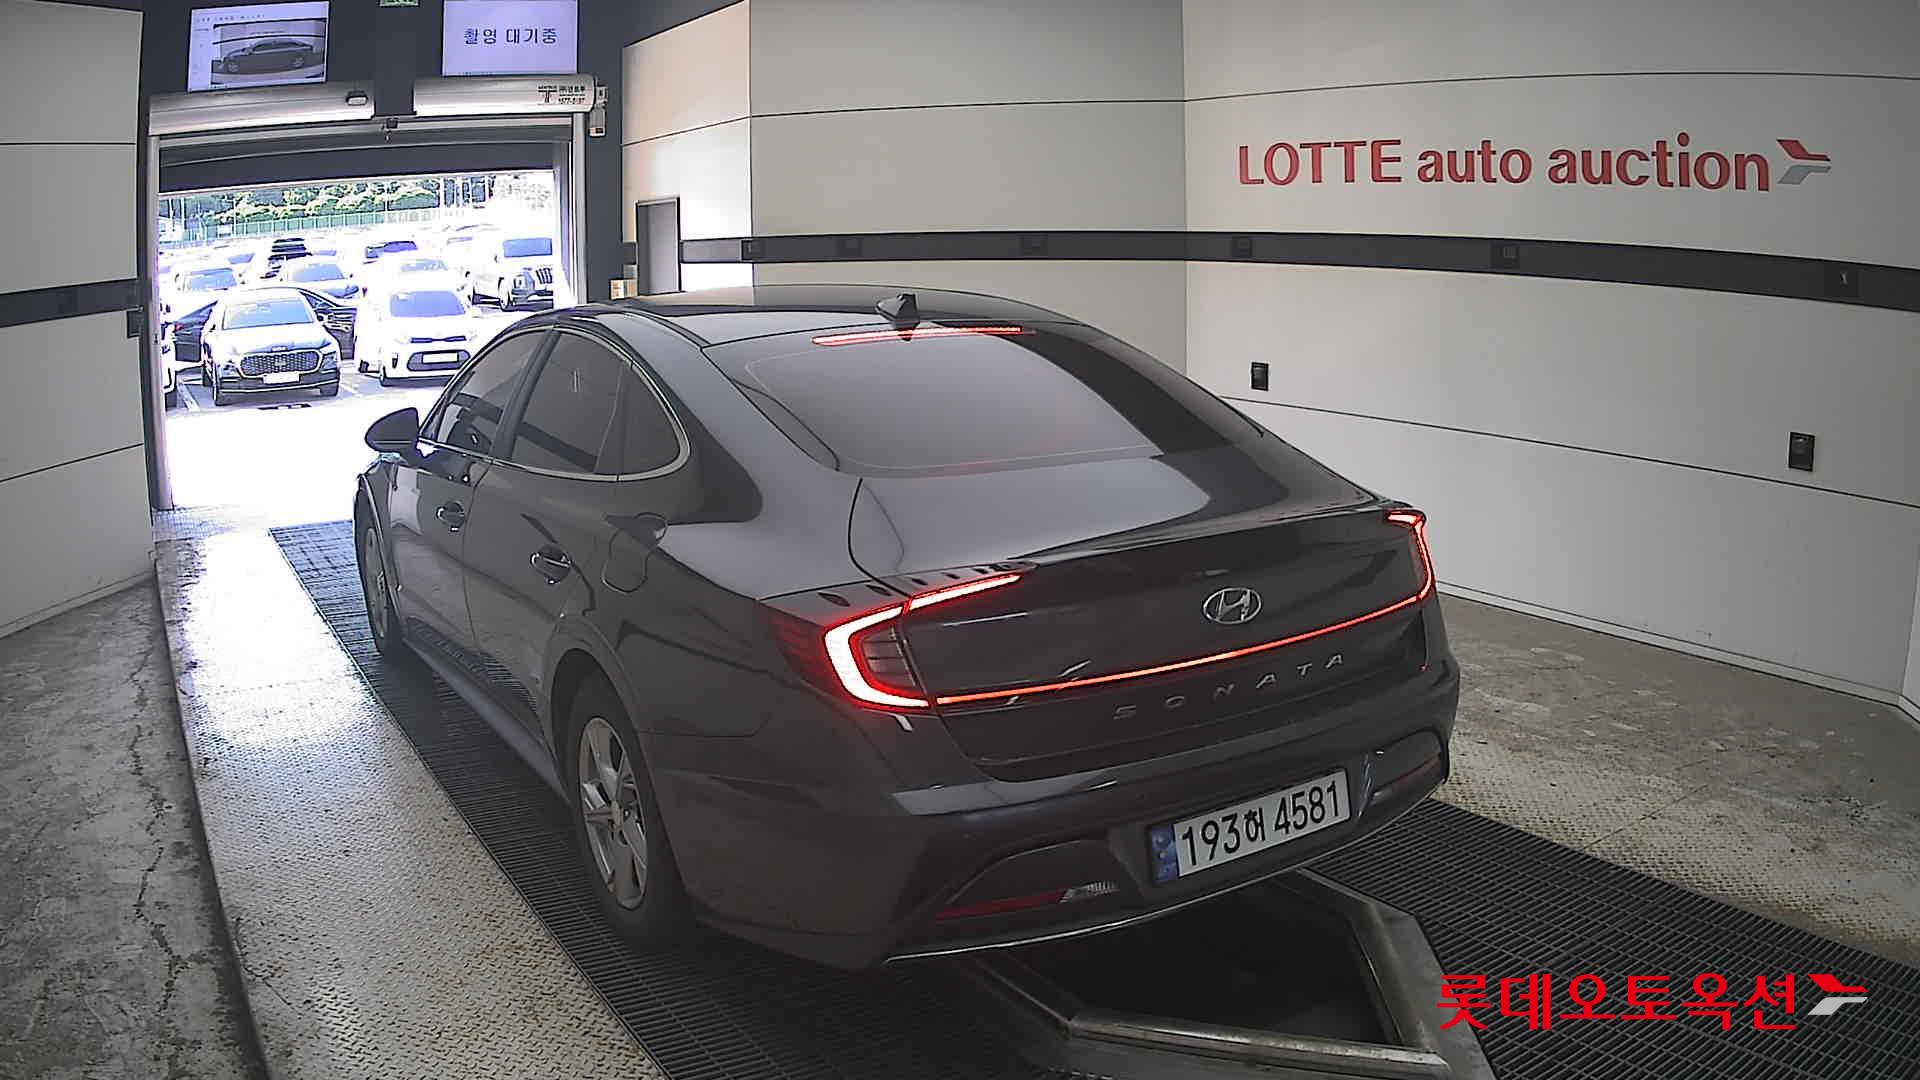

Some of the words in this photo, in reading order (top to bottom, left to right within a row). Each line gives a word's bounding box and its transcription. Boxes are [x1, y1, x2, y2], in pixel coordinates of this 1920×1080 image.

[506, 28, 558, 45] 대기중
[1239, 140, 1402, 186] LOTTE
[1418, 140, 1532, 184] auto
[1548, 133, 1769, 192] auction
[1113, 653, 1344, 719] SONATA
[1181, 807, 1266, 866] 193허
[1273, 780, 1340, 835] 4581
